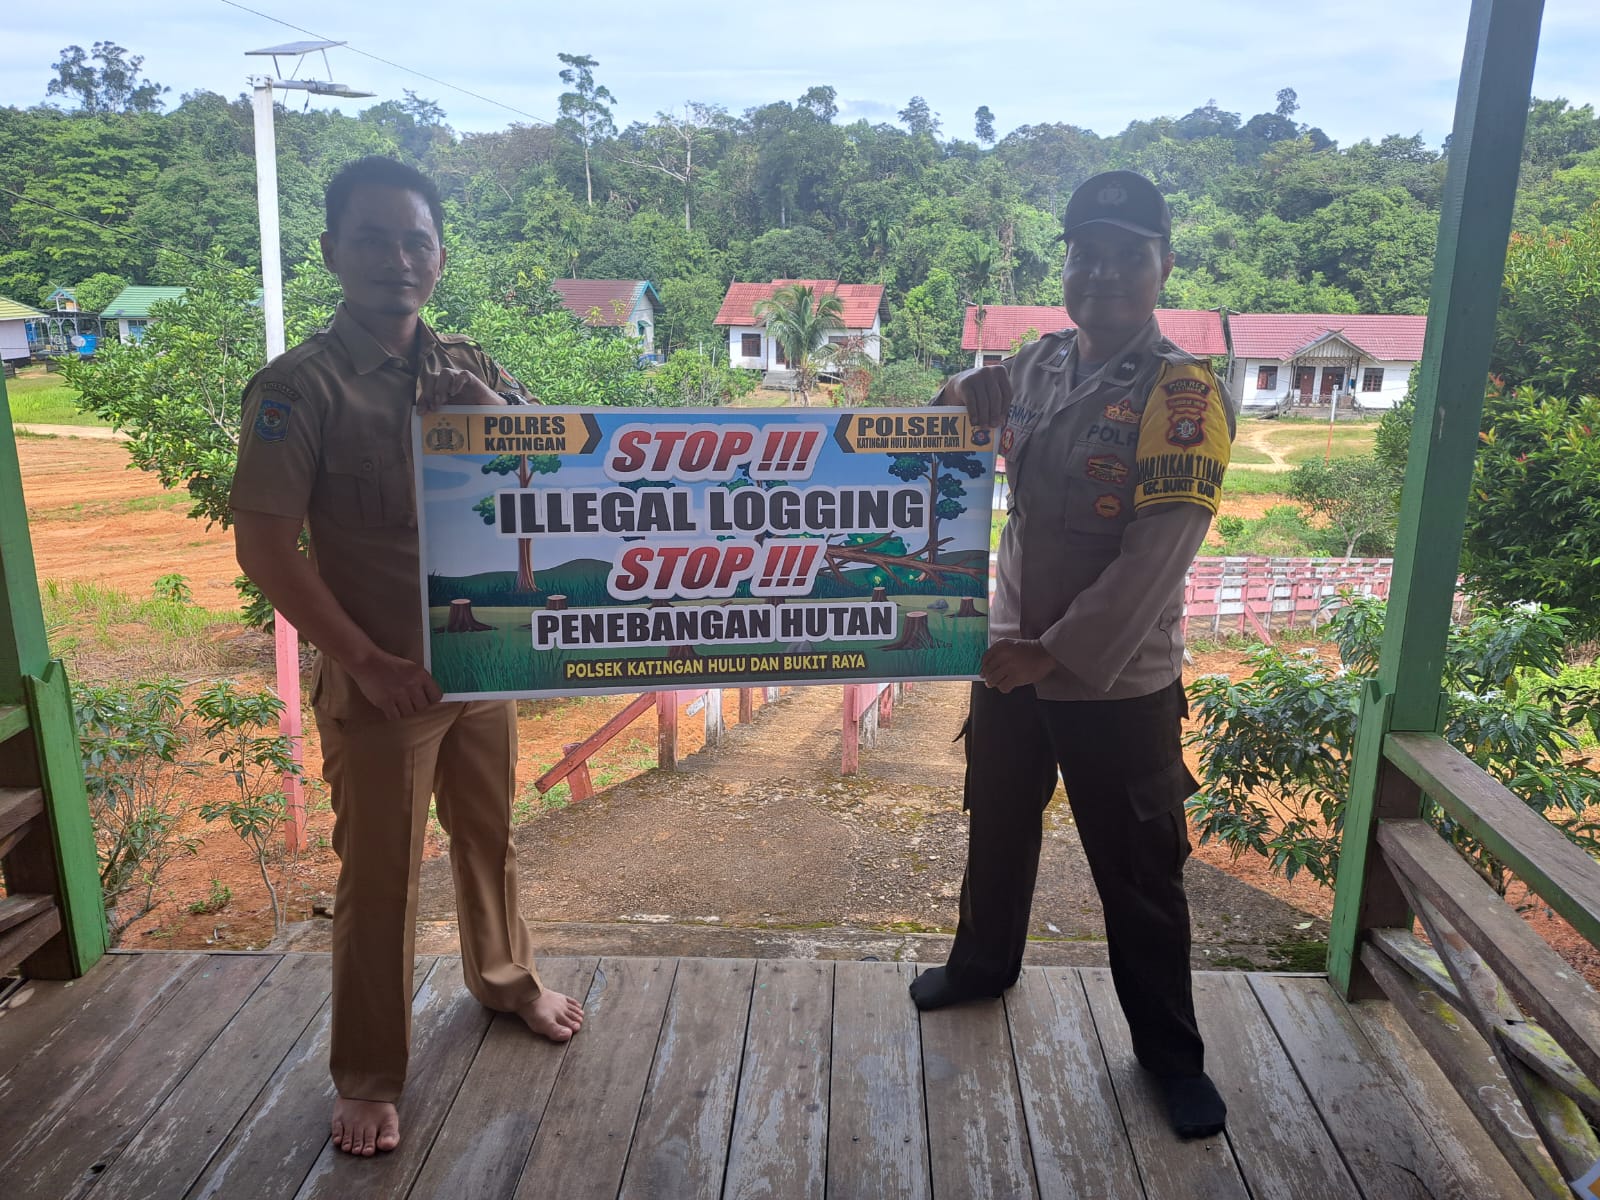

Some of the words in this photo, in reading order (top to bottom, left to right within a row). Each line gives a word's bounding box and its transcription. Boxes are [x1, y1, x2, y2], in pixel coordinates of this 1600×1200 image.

[484, 415, 566, 435] POLRES
[857, 416, 959, 436] POLSEK
[1008, 405, 1038, 425] ENNY
[484, 437, 566, 451] KATINGAN
[856, 437, 889, 449] KATINGAN
[890, 437, 907, 448] HULU
[908, 437, 922, 448] DAN
[922, 437, 943, 448] BUKIT
[943, 436, 960, 448] RAYA
[1086, 424, 1138, 446] POLR
[611, 430, 754, 473] STOP
[500, 492, 696, 534] ILLEGAL
[709, 490, 923, 531] LOGGING
[615, 545, 755, 591] STOP
[537, 609, 771, 645] PENEBANGAN
[781, 606, 892, 638] HUTAN
[566, 661, 622, 678] POLSEK
[627, 659, 702, 676] KATINGAN
[708, 657, 746, 673] HULU
[751, 656, 779, 671] DAN
[784, 655, 828, 670] BUKIT
[832, 654, 865, 669] RAYA
